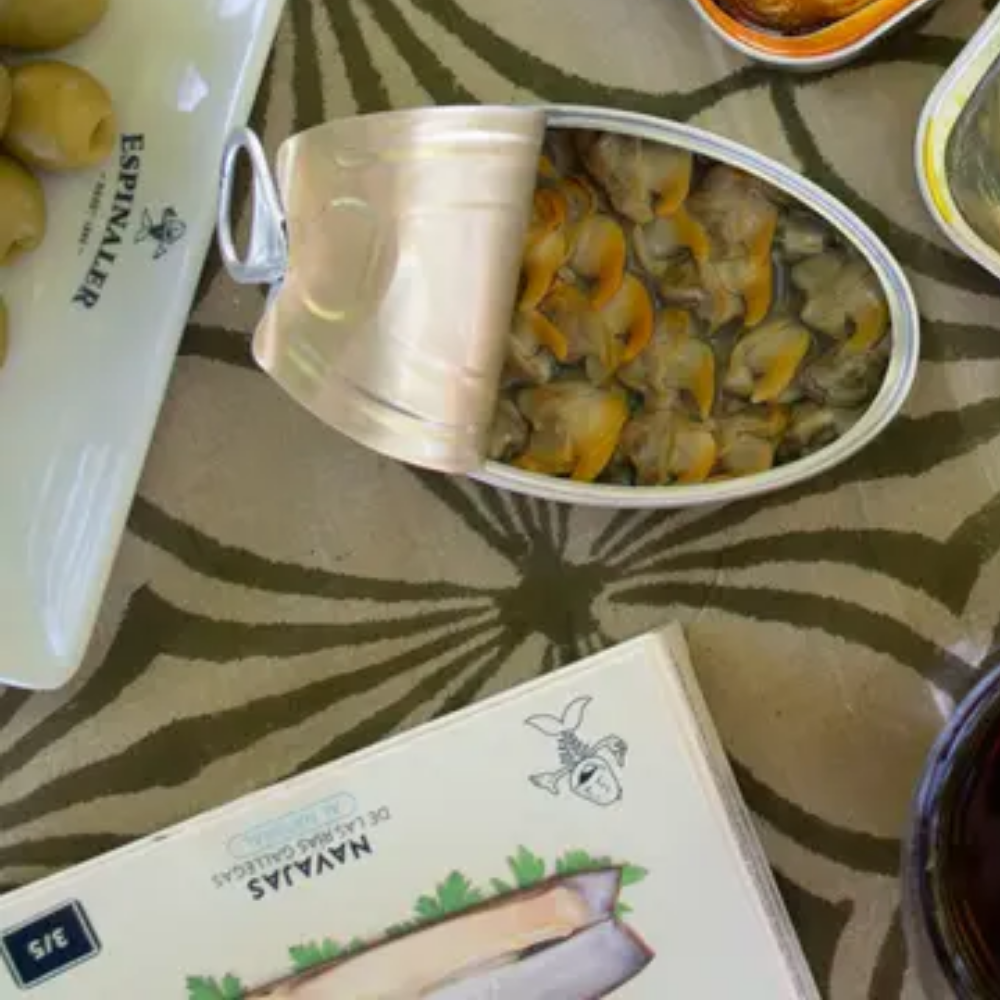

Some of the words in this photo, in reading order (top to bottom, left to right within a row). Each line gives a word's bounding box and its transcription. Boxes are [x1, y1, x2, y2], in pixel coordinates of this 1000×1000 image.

[71, 133, 145, 309] ESPINALER
[334, 816, 366, 838] LAS
[368, 805, 391, 826] DE
[211, 845, 296, 888] GALLEGAS
[246, 834, 373, 901] NAVAJAS
[27, 926, 69, 961] 3/5
